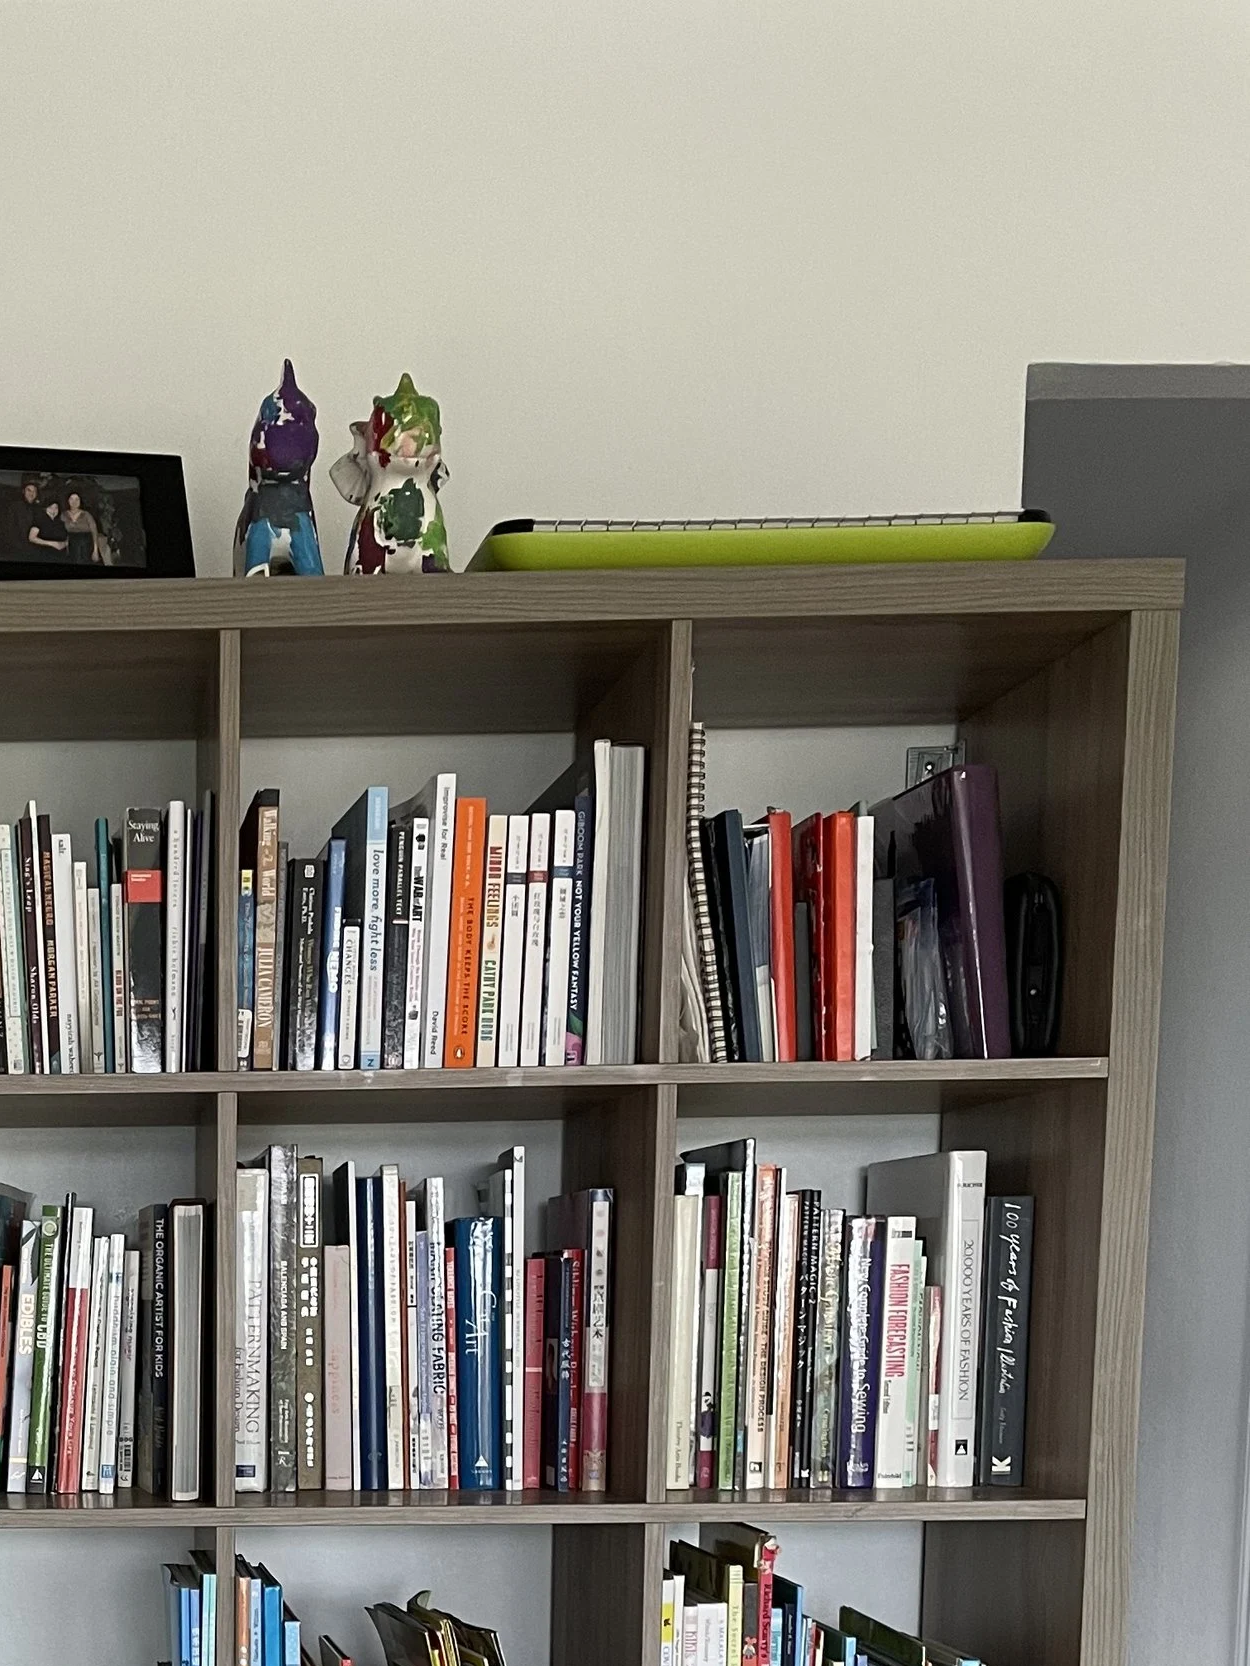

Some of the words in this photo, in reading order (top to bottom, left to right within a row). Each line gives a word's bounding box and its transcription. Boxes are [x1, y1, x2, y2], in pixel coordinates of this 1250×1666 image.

[372, 849, 383, 875] love
[575, 881, 583, 900] NOT
[369, 916, 382, 945] fight
[573, 903, 581, 927] YOUR
[370, 947, 379, 971] less
[572, 931, 580, 968] YELLOW
[570, 971, 579, 1010] FANTASY
[155, 1219, 164, 1239] THE
[154, 1241, 164, 1290] ORGANIC
[888, 1264, 910, 1307] FASHION
[18, 1294, 35, 1355] EDIBLES
[155, 1292, 164, 1327] ARTIST
[961, 1289, 972, 1327] YEARS
[155, 1330, 164, 1351] FOR
[884, 1310, 908, 1378] FORECASTING
[961, 1330, 971, 1346] OF
[155, 1354, 164, 1377] KIDS
[246, 1279, 263, 1433] PATTERNMAKING
[958, 1349, 970, 1401] FASHION
